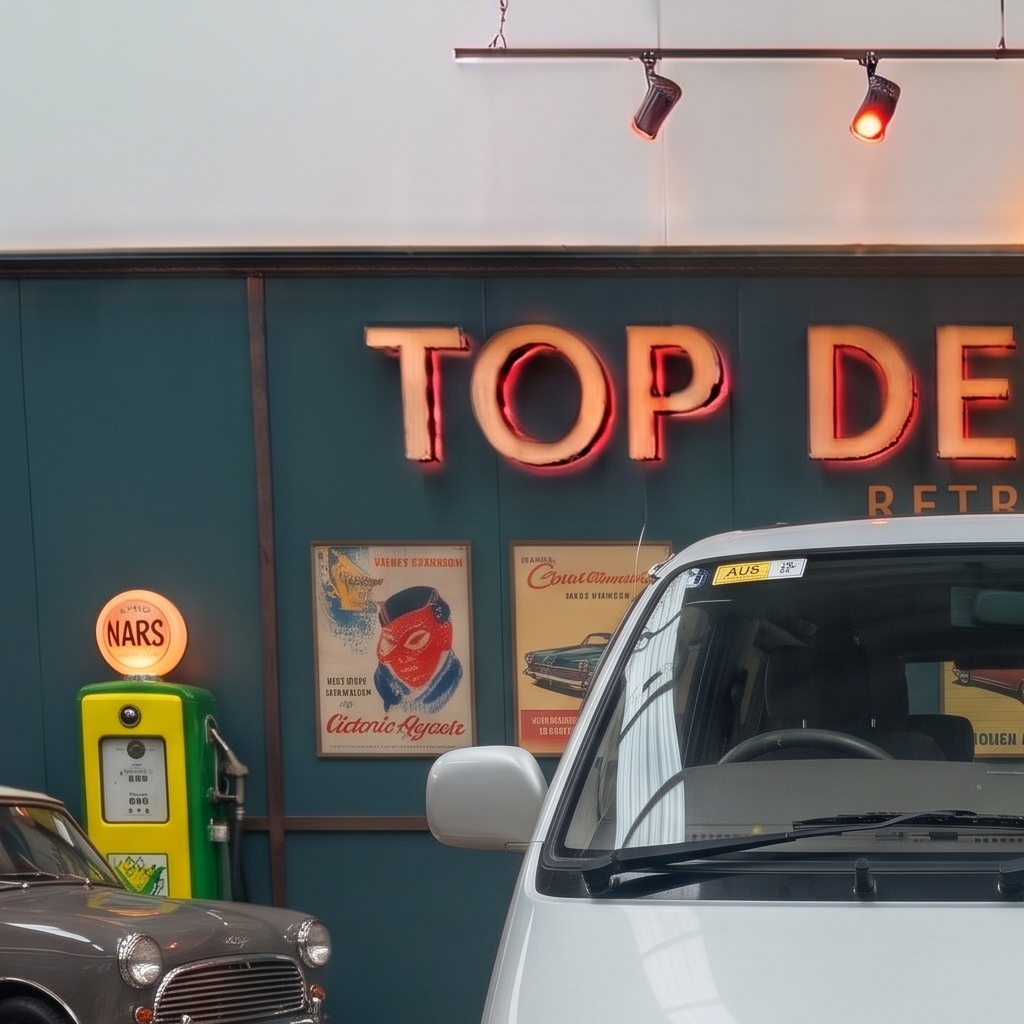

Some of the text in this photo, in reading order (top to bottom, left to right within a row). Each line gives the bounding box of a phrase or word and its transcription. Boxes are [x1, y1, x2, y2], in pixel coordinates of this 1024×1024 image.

[364, 325, 729, 467] TOP
[725, 565, 760, 577] AUS
[107, 618, 165, 648] NARS
